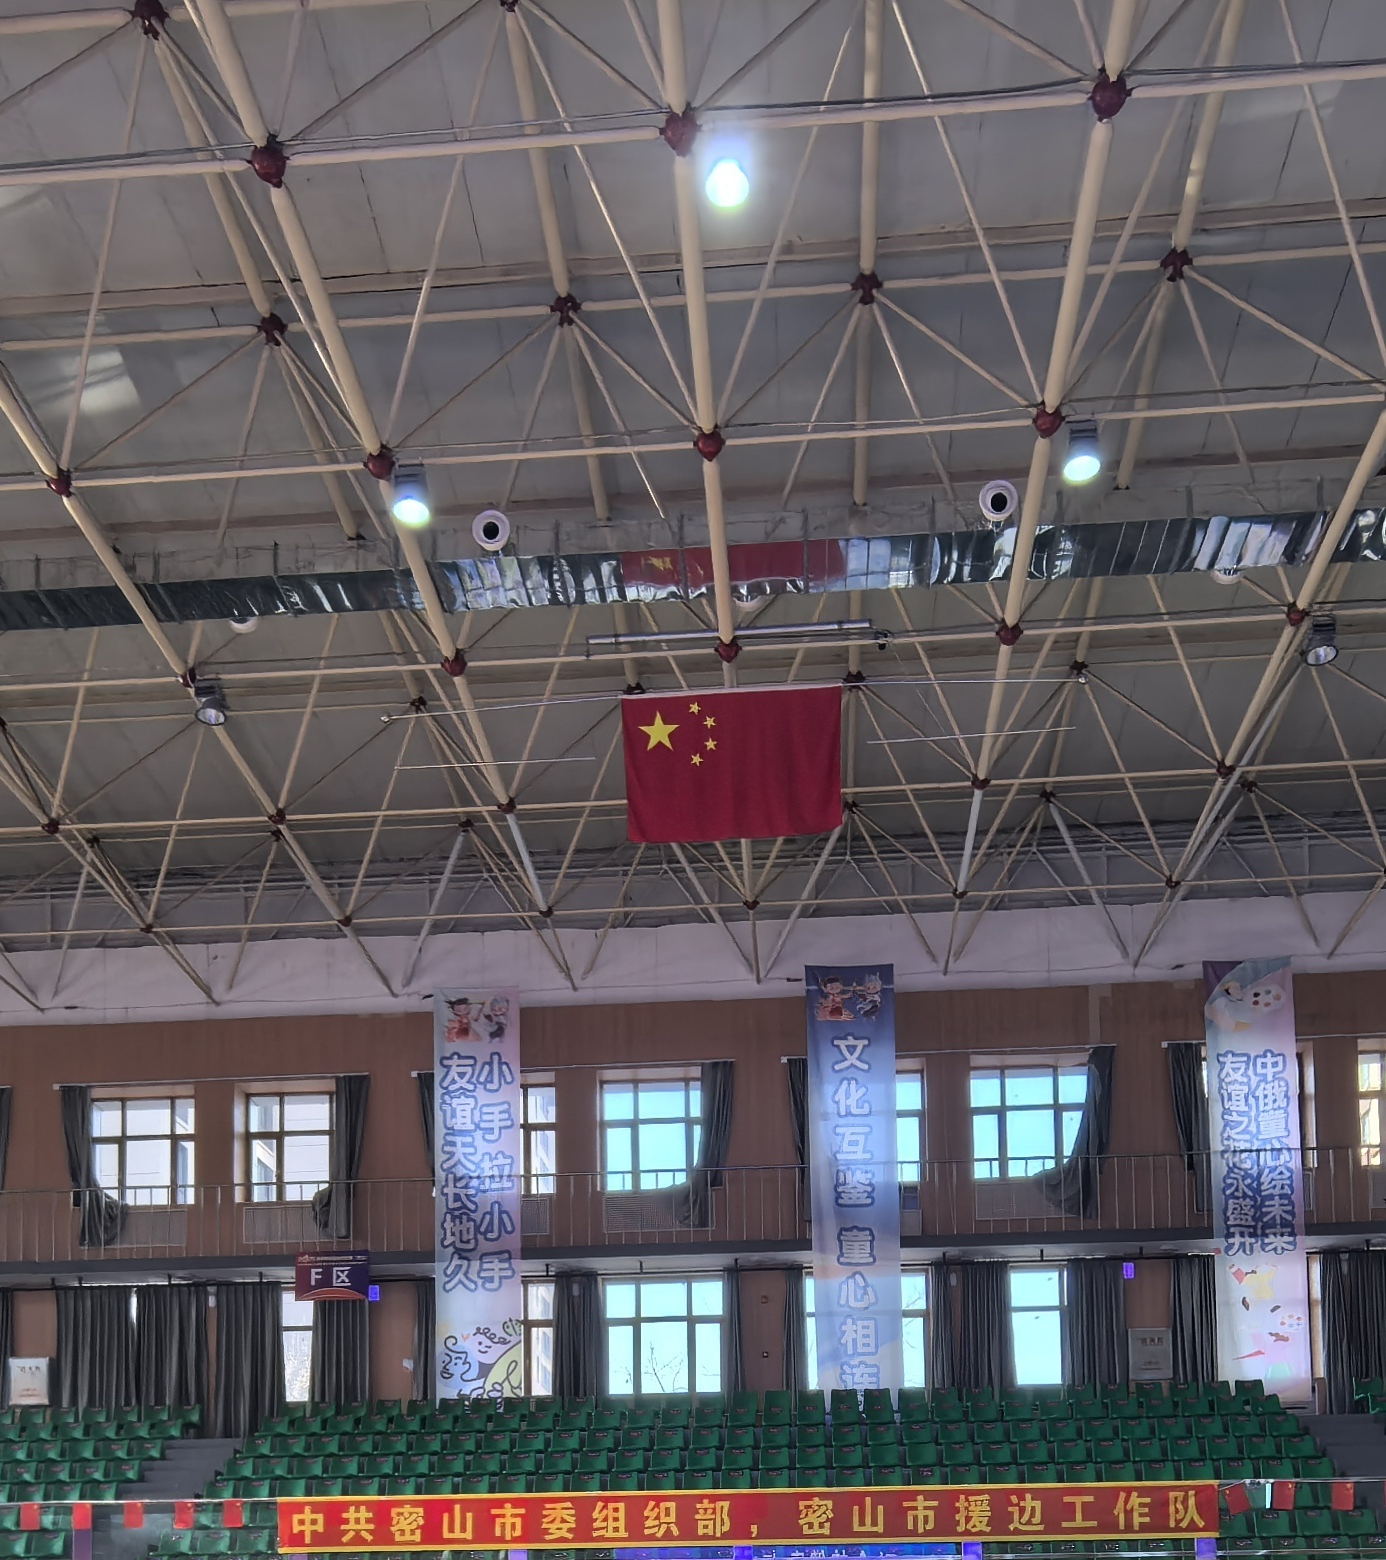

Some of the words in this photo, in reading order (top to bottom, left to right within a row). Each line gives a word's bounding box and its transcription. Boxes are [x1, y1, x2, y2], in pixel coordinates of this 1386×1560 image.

[439, 1052, 478, 1292] 友谊天长地久
[477, 1052, 515, 1292] 小手拉小手
[832, 1034, 875, 1208] 文化互鉴
[1217, 1051, 1258, 1256] 友谊之花永盛开
[1253, 1050, 1297, 1255] 中俄童心绘未来
[292, 1492, 1205, 1544] 中共密山市委组织部，密山市援边工作队
